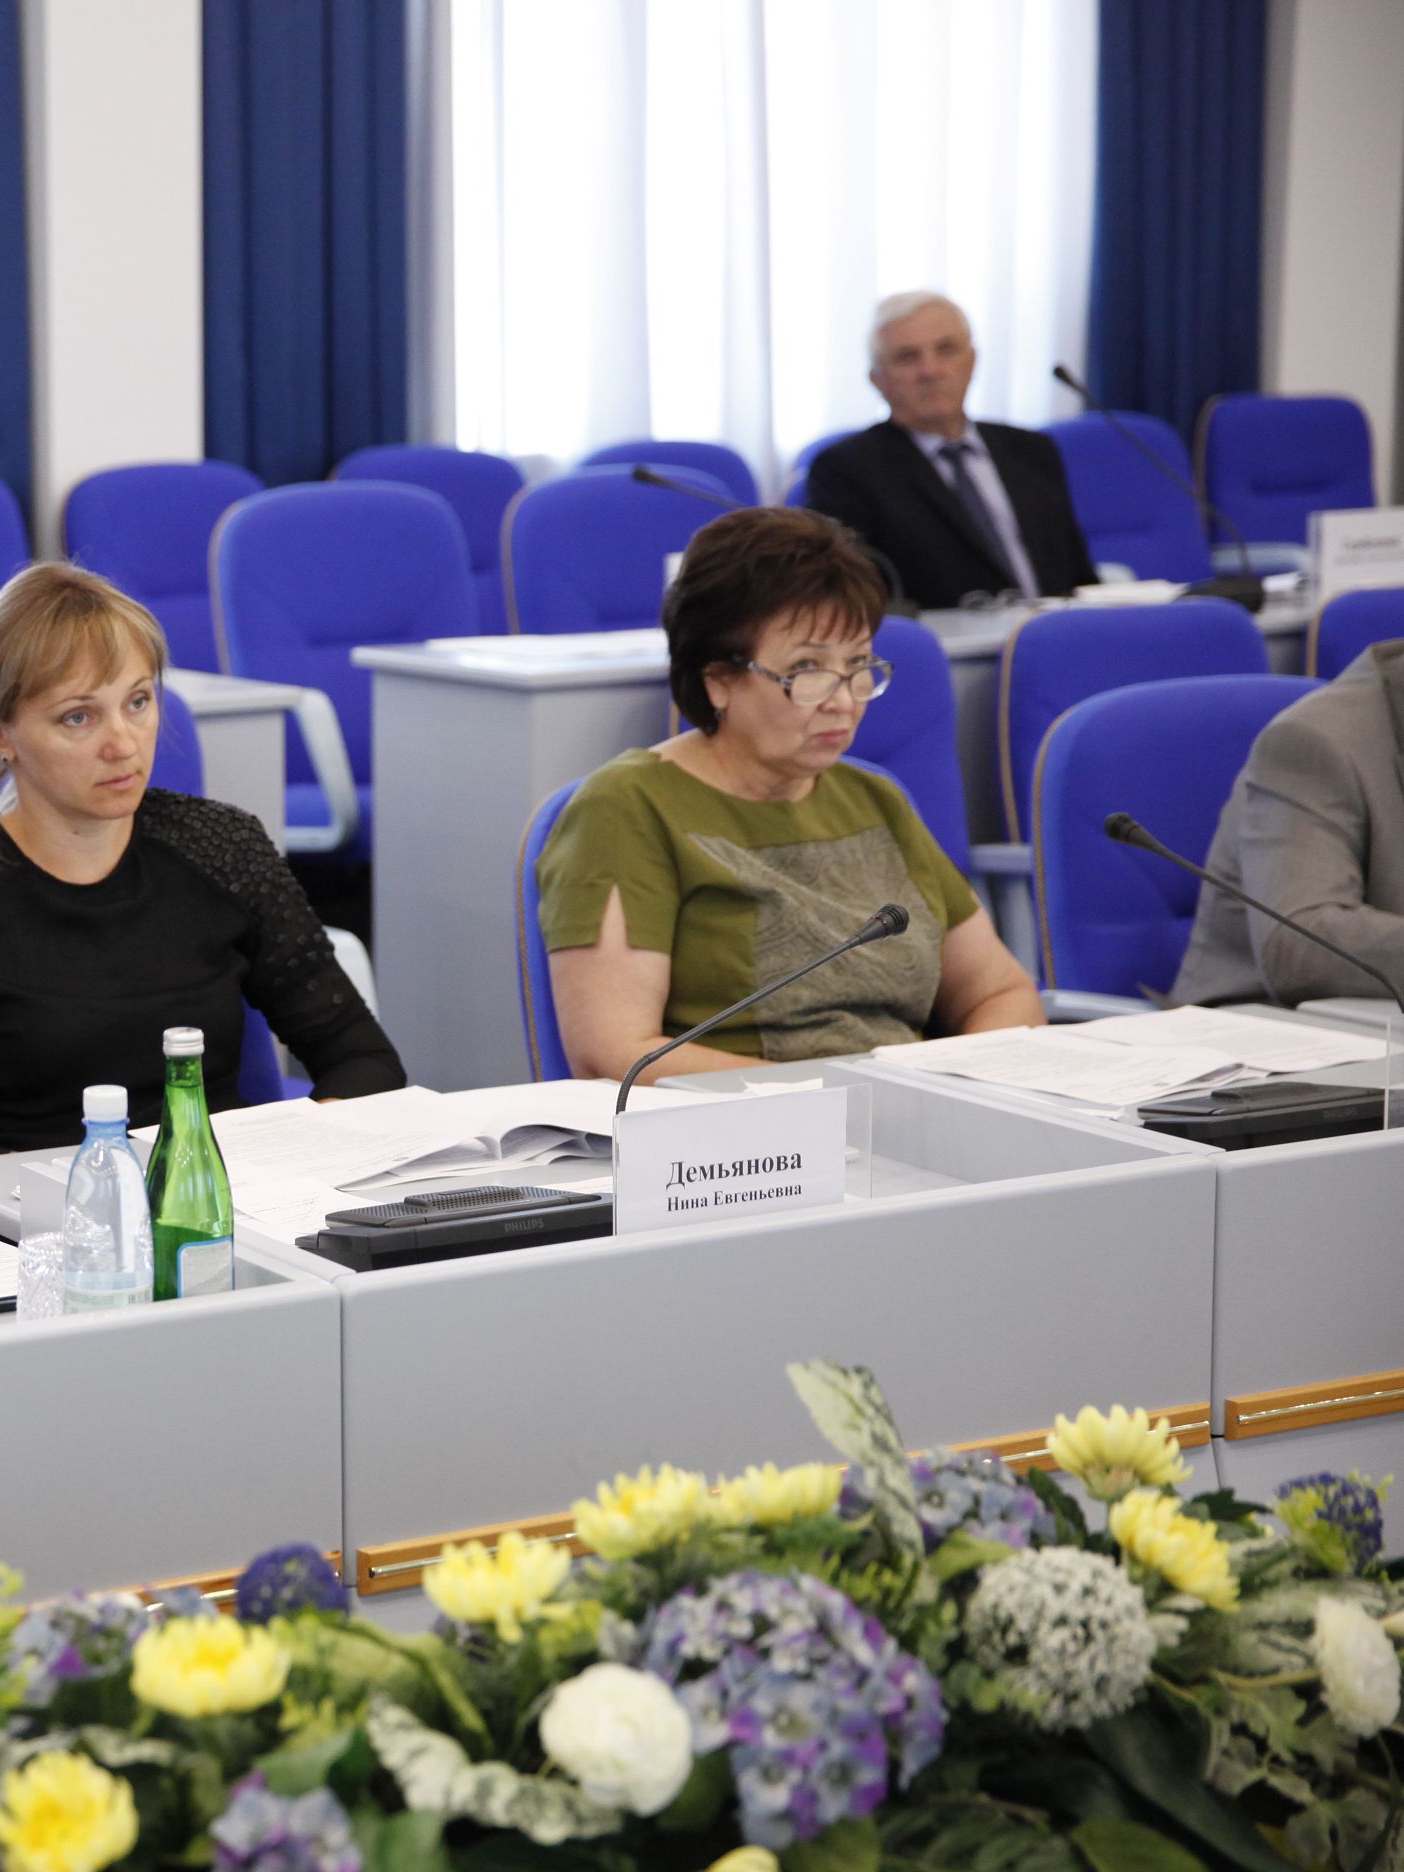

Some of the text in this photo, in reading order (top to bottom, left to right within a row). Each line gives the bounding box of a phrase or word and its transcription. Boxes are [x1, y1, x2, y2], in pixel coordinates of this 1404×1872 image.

[665, 1152, 803, 1191] Демьянова
[667, 1183, 803, 1212] Нина Евгеньевна
[504, 1218, 545, 1233] PHILIPS
